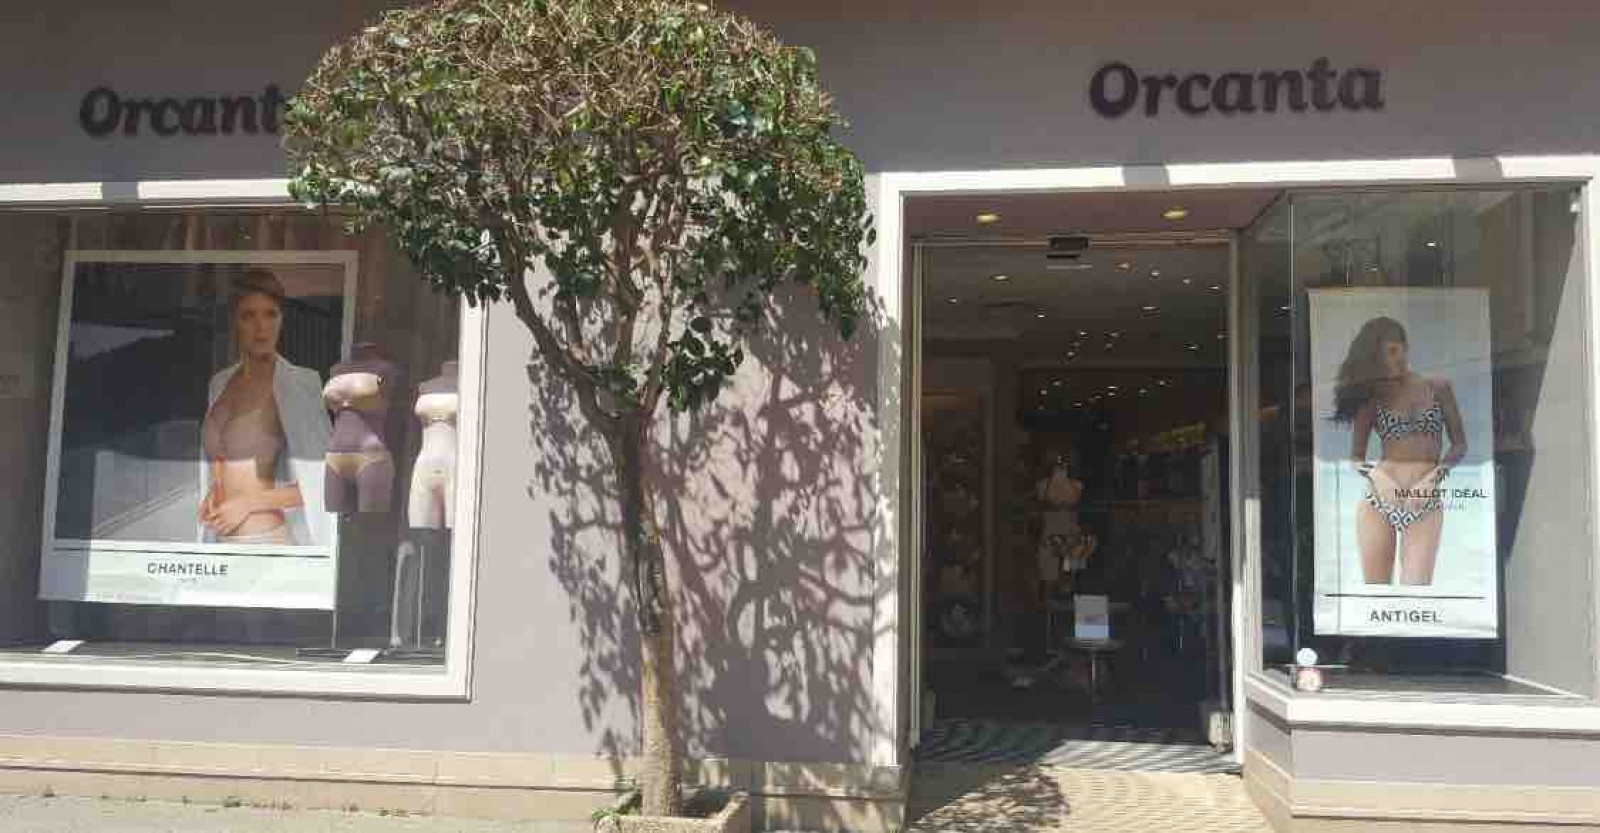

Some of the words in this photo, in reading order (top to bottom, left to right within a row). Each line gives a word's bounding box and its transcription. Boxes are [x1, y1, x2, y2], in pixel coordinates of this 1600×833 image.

[1090, 57, 1386, 118] Orcanta
[79, 85, 285, 137] Orcant
[1394, 488, 1446, 499] MAILLOT
[147, 562, 228, 576] CHANTELLE
[1370, 609, 1443, 623] ANTIGEL
